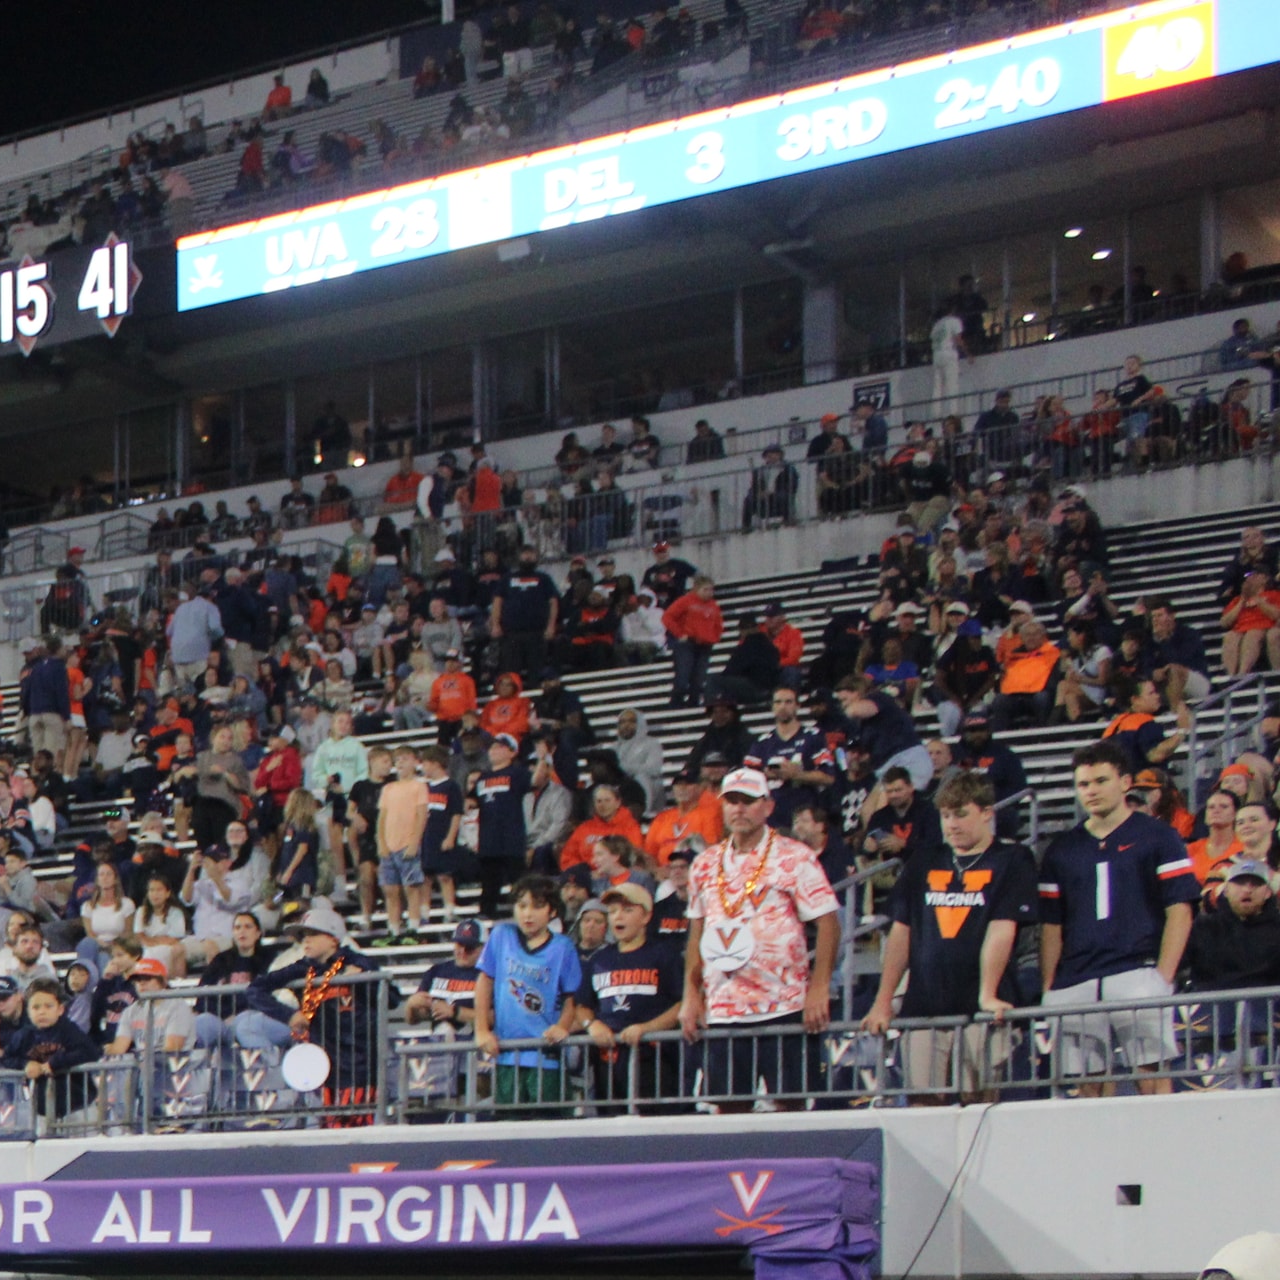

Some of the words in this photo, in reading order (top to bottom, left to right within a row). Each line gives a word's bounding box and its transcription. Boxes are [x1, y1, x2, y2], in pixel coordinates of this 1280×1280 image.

[265, 225, 348, 277] UVA
[370, 197, 440, 259] 28
[685, 131, 726, 184] 3
[776, 96, 888, 162] 3RD
[934, 55, 1063, 130] 2:40
[1116, 17, 1206, 81] 40
[0, 262, 50, 344] 15
[77, 242, 129, 319] 41
[924, 890, 985, 907] VIRGINIA
[1095, 862, 1110, 921] 1
[92, 1188, 212, 1244] ALL
[261, 1182, 580, 1244] VIRGINIA
